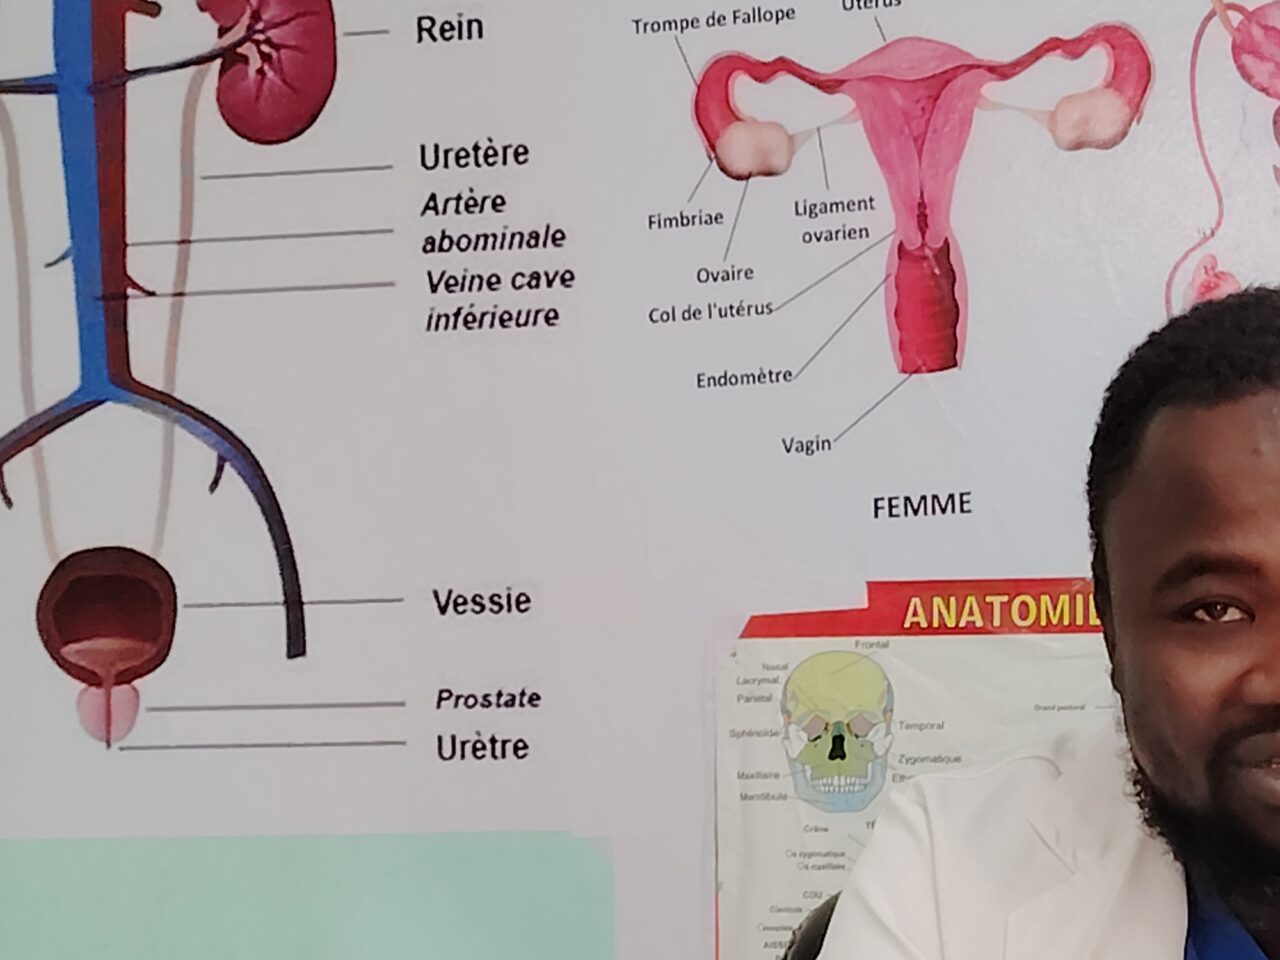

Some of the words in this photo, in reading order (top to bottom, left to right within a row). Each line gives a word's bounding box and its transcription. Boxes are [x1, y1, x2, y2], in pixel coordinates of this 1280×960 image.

[417, 13, 483, 43] Rein
[632, 17, 699, 34] Trompe
[706, 11, 726, 27] de
[733, 7, 795, 24] Fallope
[421, 138, 529, 170] Uretère
[421, 187, 506, 216] Artère
[795, 196, 875, 219] Ligament
[649, 210, 723, 229] Fimbriae
[422, 224, 566, 254] abominale
[803, 224, 869, 243] ovarien
[427, 269, 501, 293] Veine
[511, 270, 575, 290] cave
[697, 265, 753, 283] Ovaire
[427, 304, 559, 331] inférieure
[649, 306, 676, 323] Col
[682, 305, 701, 321] de
[708, 300, 773, 319] l'utérus
[696, 367, 793, 389] Endomètre
[782, 436, 832, 456] Vagin
[874, 492, 971, 518] FEMME
[433, 588, 531, 615] Vessie
[855, 640, 890, 649] Frontal
[437, 689, 541, 709] Prostate
[899, 721, 945, 732] Temporal
[438, 731, 529, 761] Urètre
[898, 754, 962, 765] Zygomatique
